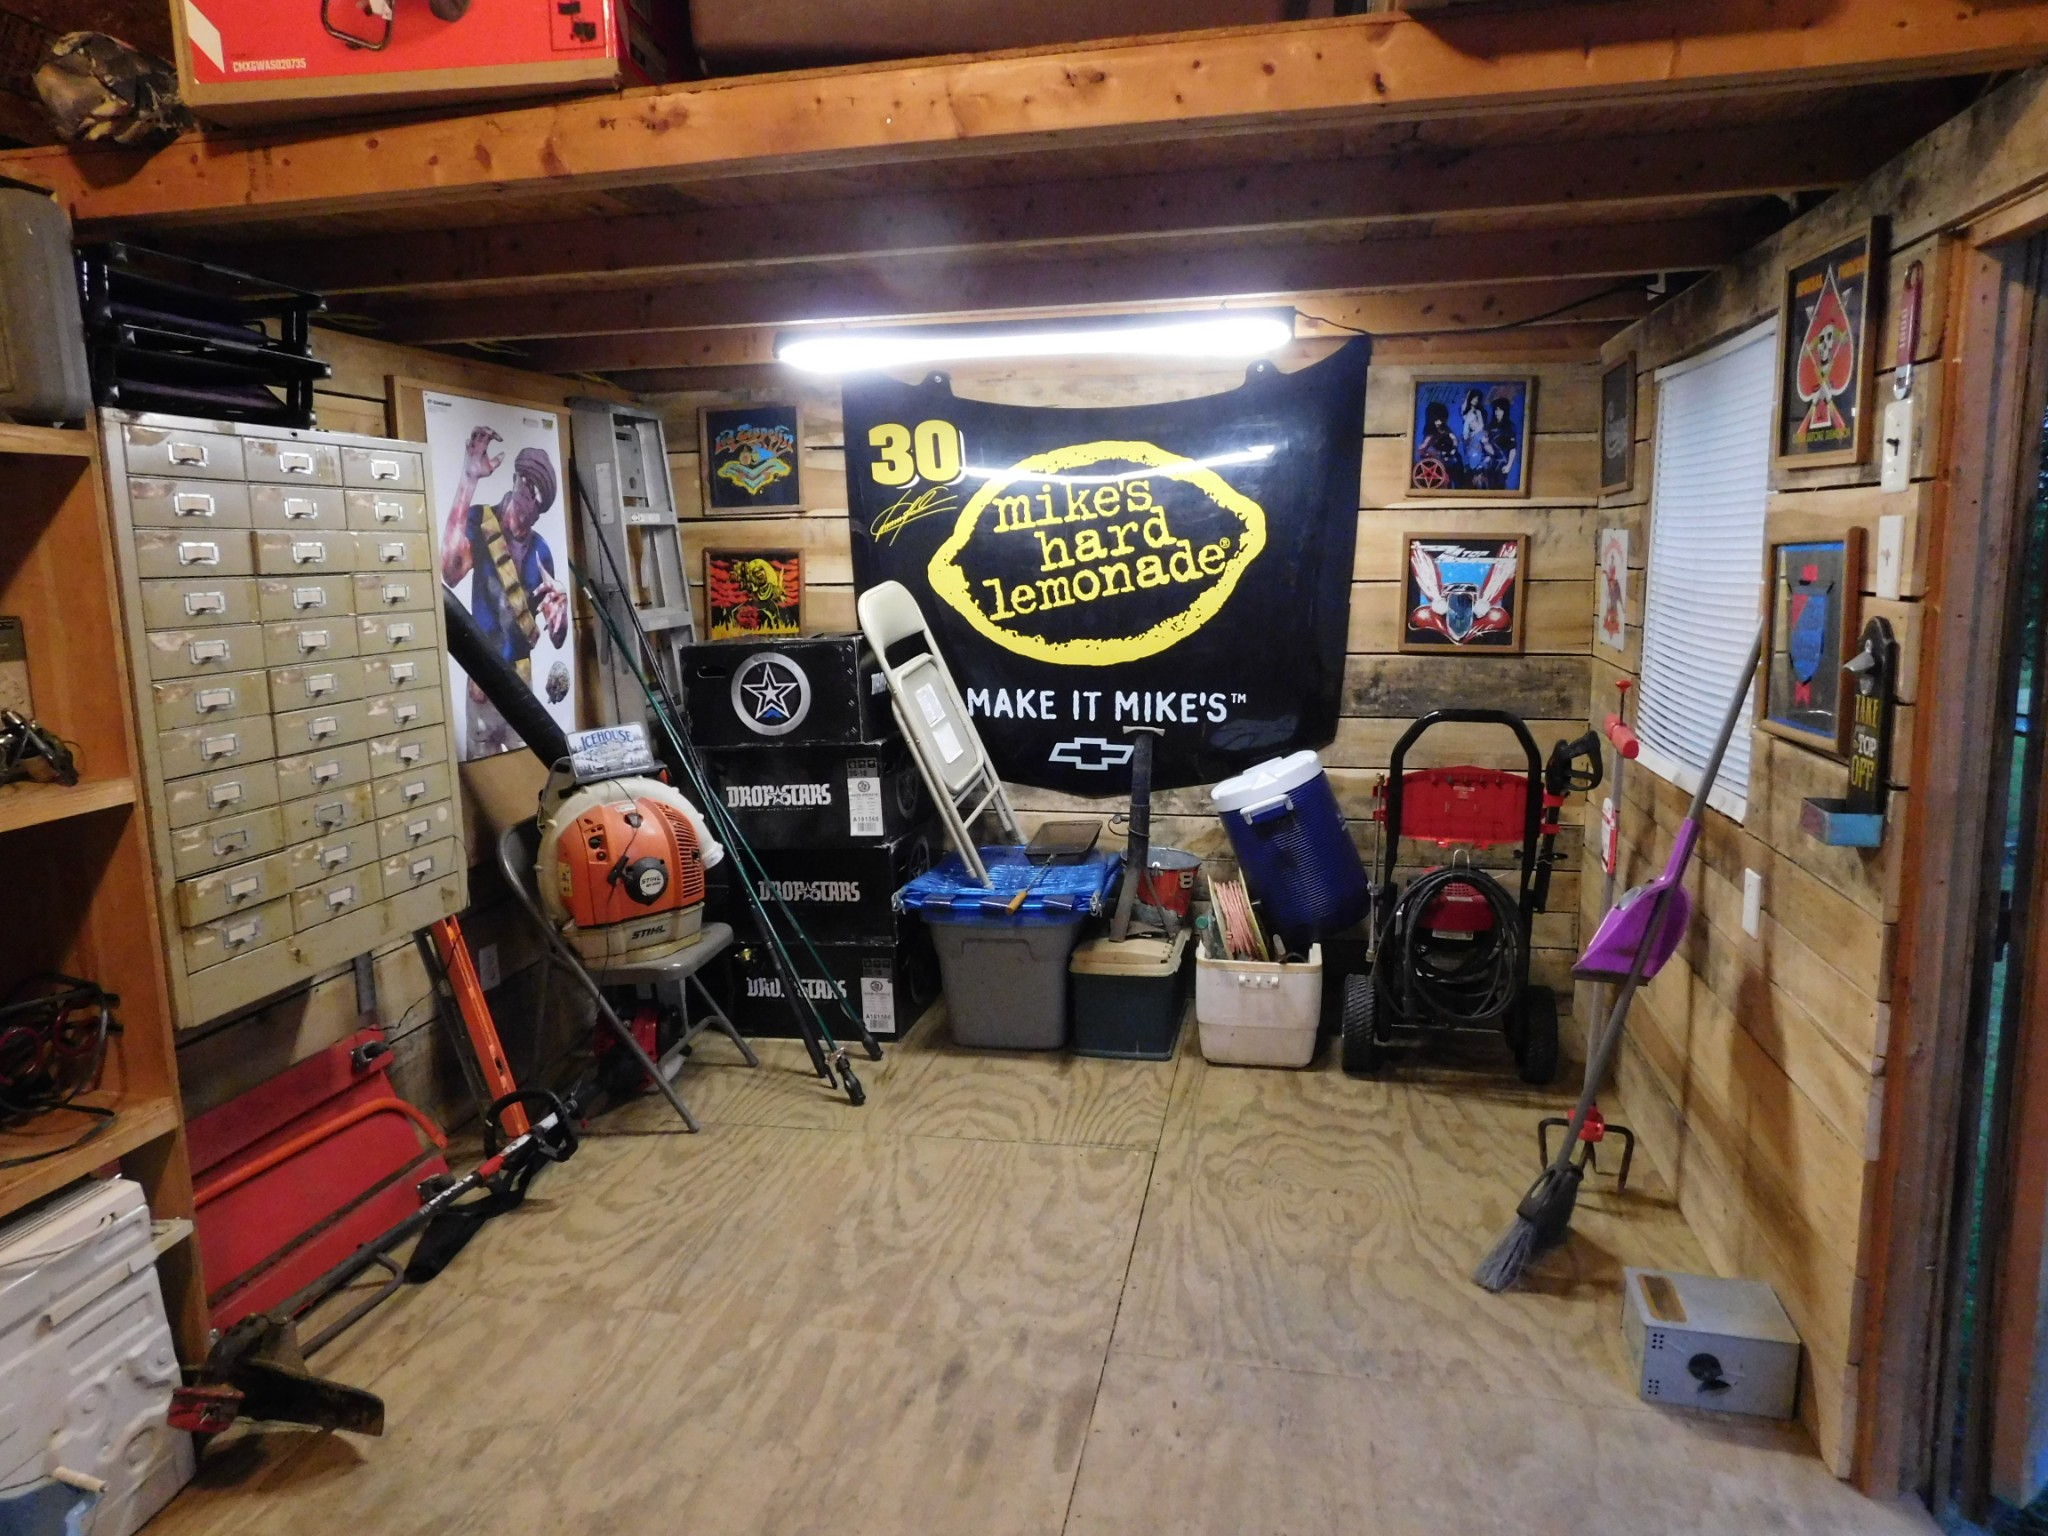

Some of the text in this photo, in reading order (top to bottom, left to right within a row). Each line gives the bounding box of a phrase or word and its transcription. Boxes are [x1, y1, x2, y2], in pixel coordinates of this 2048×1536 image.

[868, 419, 964, 488] 30
[992, 480, 1154, 533] mike's
[1034, 505, 1178, 572] hard
[967, 687, 1057, 720] MAKE
[1073, 690, 1102, 721] IT
[581, 729, 634, 751] ICEHOUSE
[1858, 733, 1877, 758] TOP
[1851, 755, 1875, 791] OFF
[641, 876, 661, 885] STIHL
[1179, 871, 1194, 889] 8
[632, 925, 666, 940] STIHL
